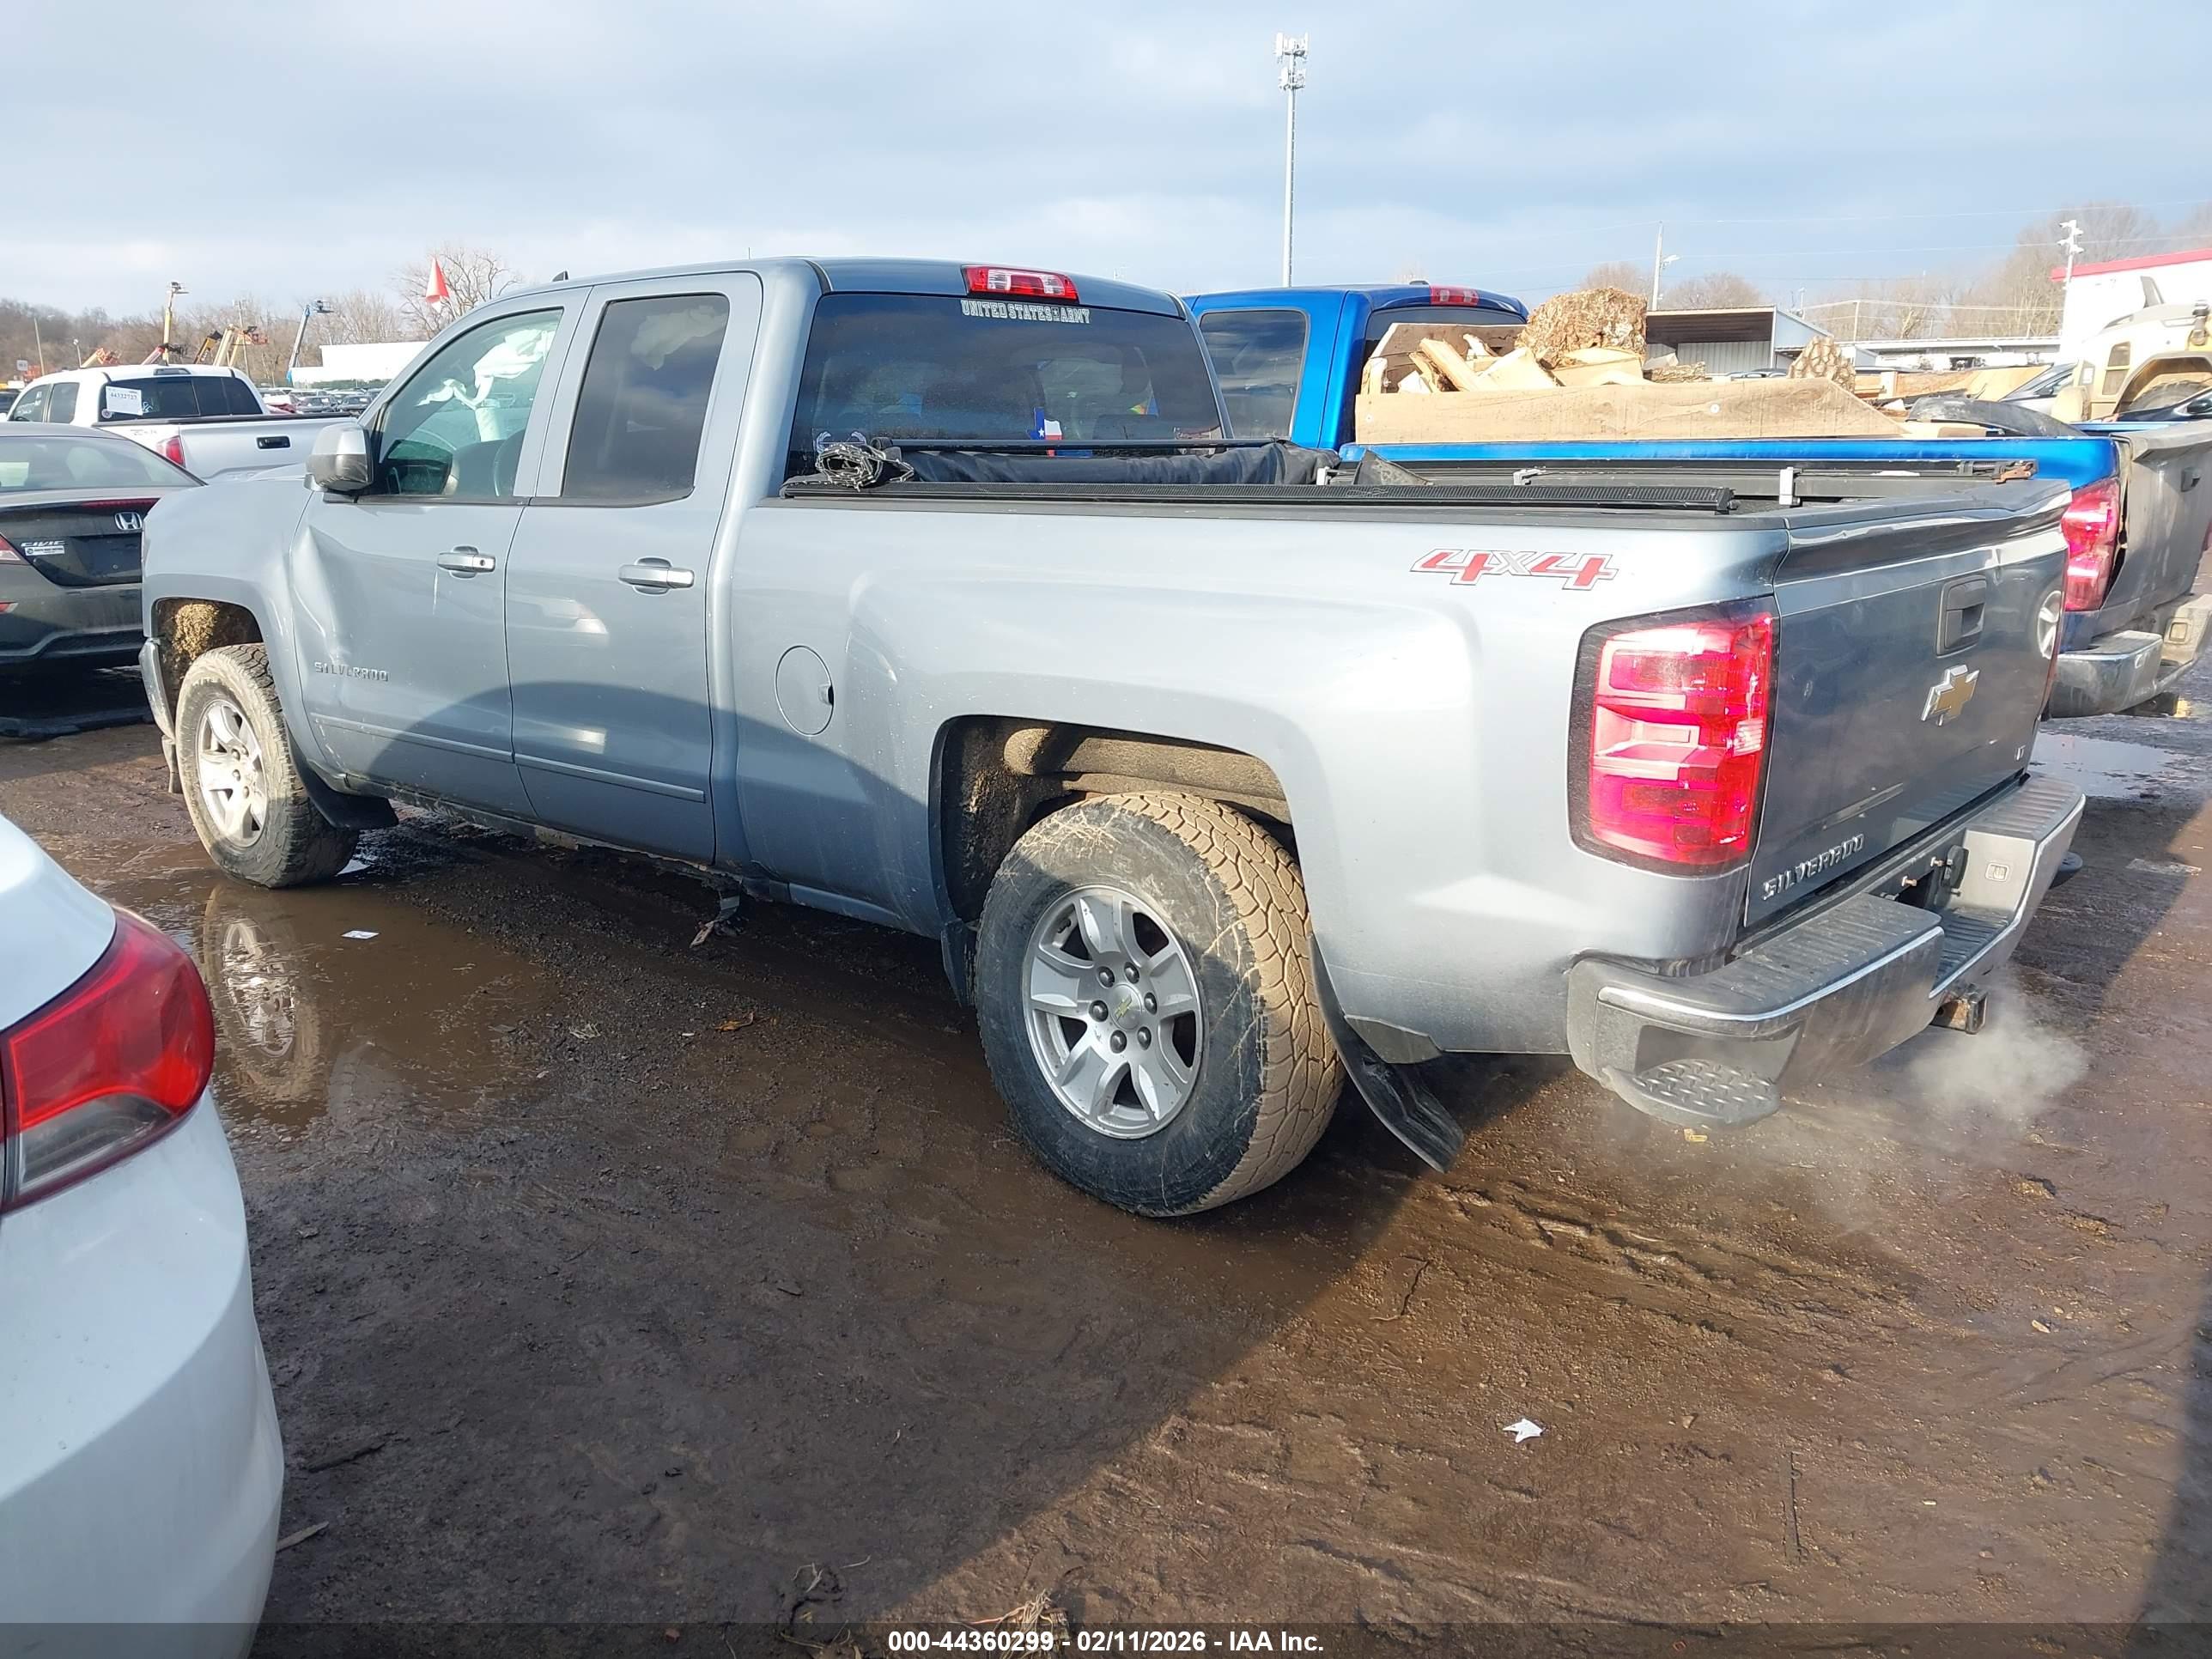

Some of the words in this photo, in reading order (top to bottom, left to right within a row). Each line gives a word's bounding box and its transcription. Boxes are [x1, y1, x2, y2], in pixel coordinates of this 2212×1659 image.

[961, 300, 1007, 319] UNITED
[1008, 303, 1053, 321] STATES
[1060, 307, 1091, 324] ARMY
[1410, 549, 1620, 591] 4X4
[314, 661, 389, 682] SILVERADO
[1763, 833, 1864, 901] SILVERADO
